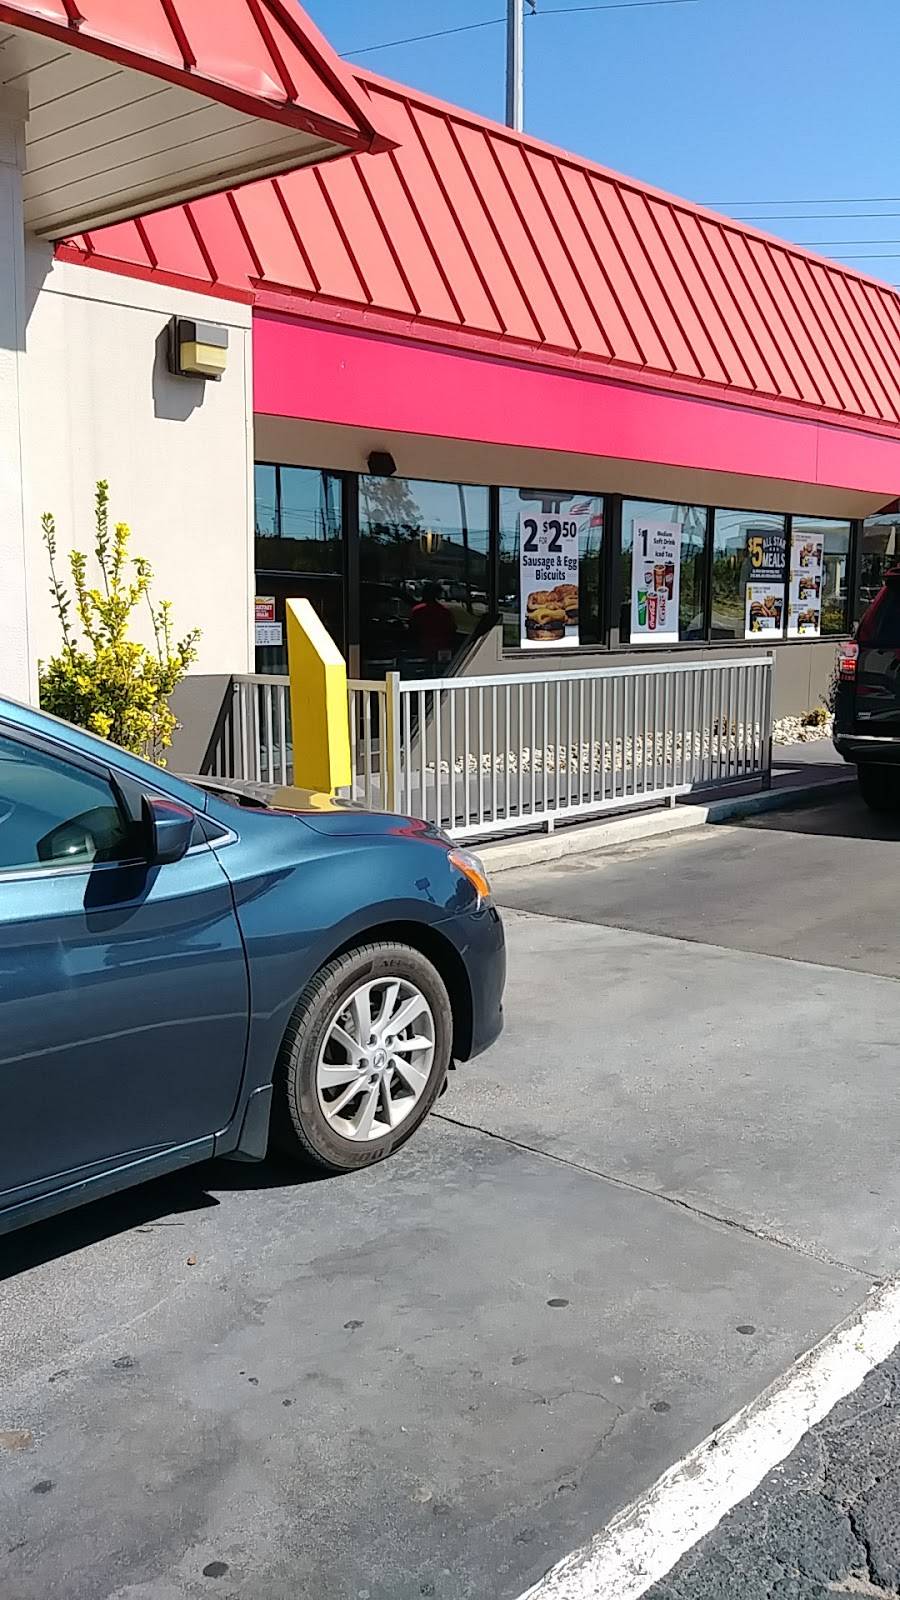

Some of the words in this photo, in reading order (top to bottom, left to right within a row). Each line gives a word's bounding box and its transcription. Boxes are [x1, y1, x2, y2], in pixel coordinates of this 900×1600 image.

[523, 519, 538, 552] 2
[539, 536, 548, 544] FOR
[664, 538, 676, 546] Drink
[763, 537, 772, 549] ALL
[748, 536, 763, 568] $5
[762, 551, 786, 568] MEALS
[523, 555, 555, 570] Sausage
[556, 556, 562, 567] &
[563, 556, 577, 571] Egg
[535, 568, 566, 581] Biscuits
